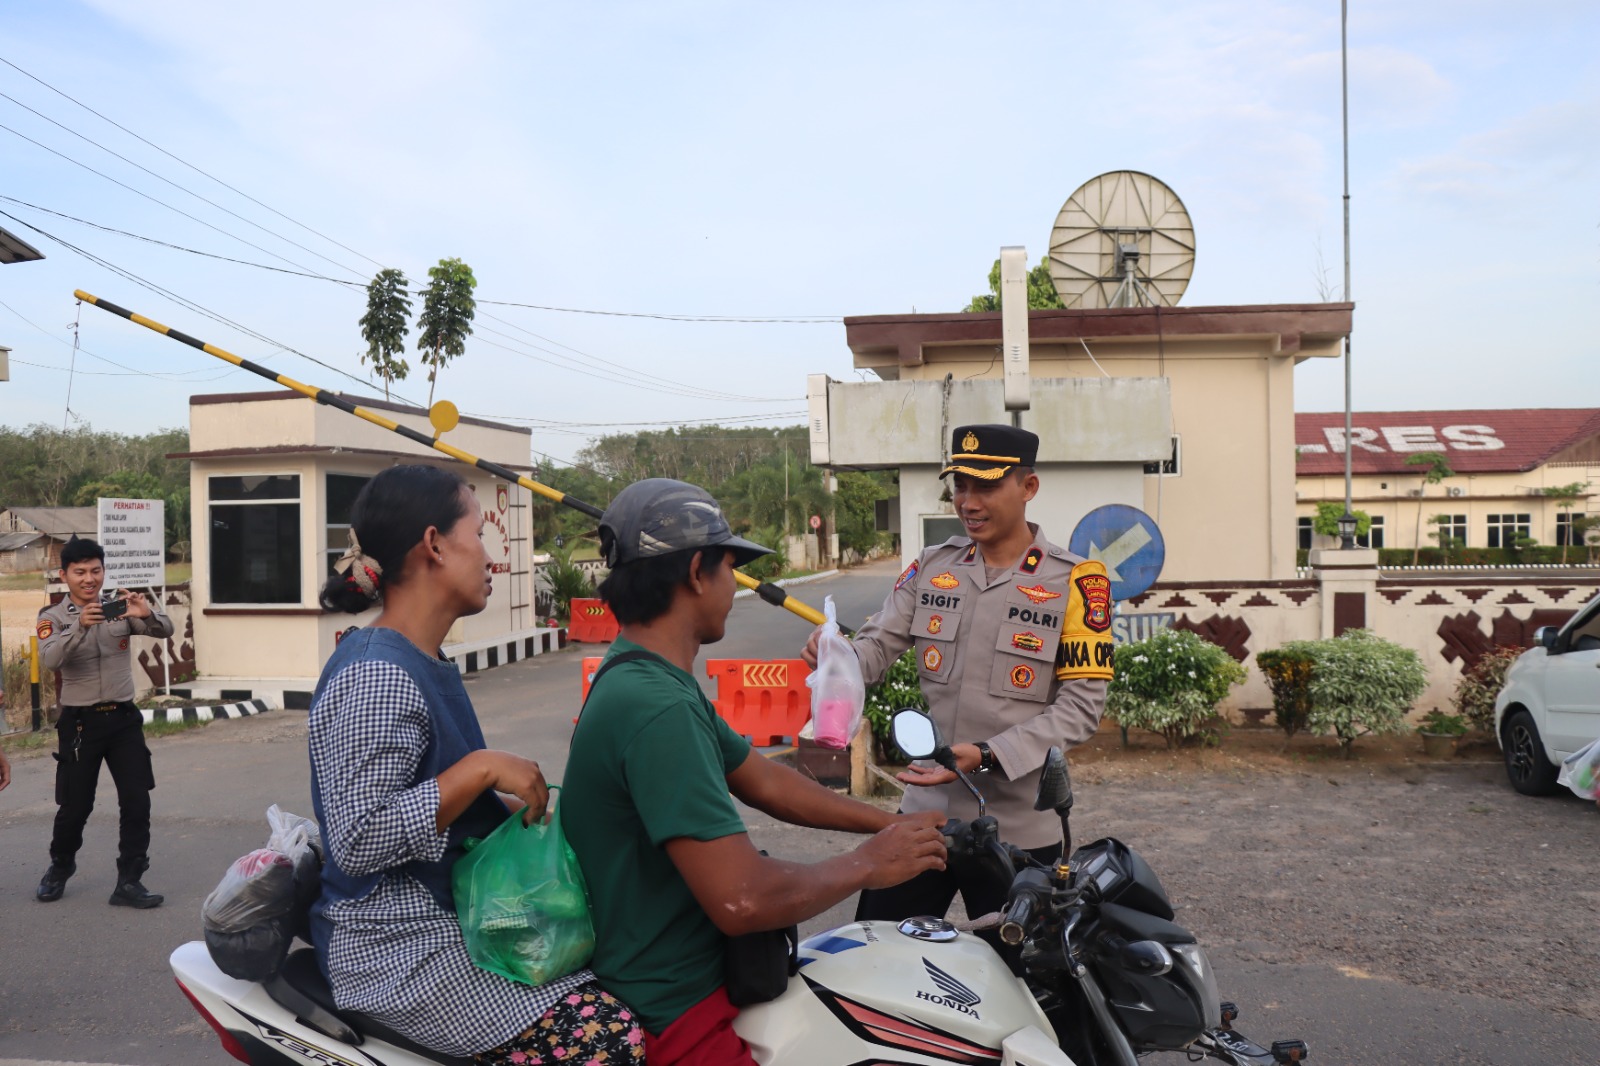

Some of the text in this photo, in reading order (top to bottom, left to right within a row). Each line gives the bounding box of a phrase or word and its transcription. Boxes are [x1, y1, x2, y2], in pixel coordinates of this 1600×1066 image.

[113, 502, 145, 510] PERHATIAN
[921, 593, 960, 609] SIGIT
[1008, 607, 1058, 629] POLRI
[915, 990, 981, 1021] HONDA
